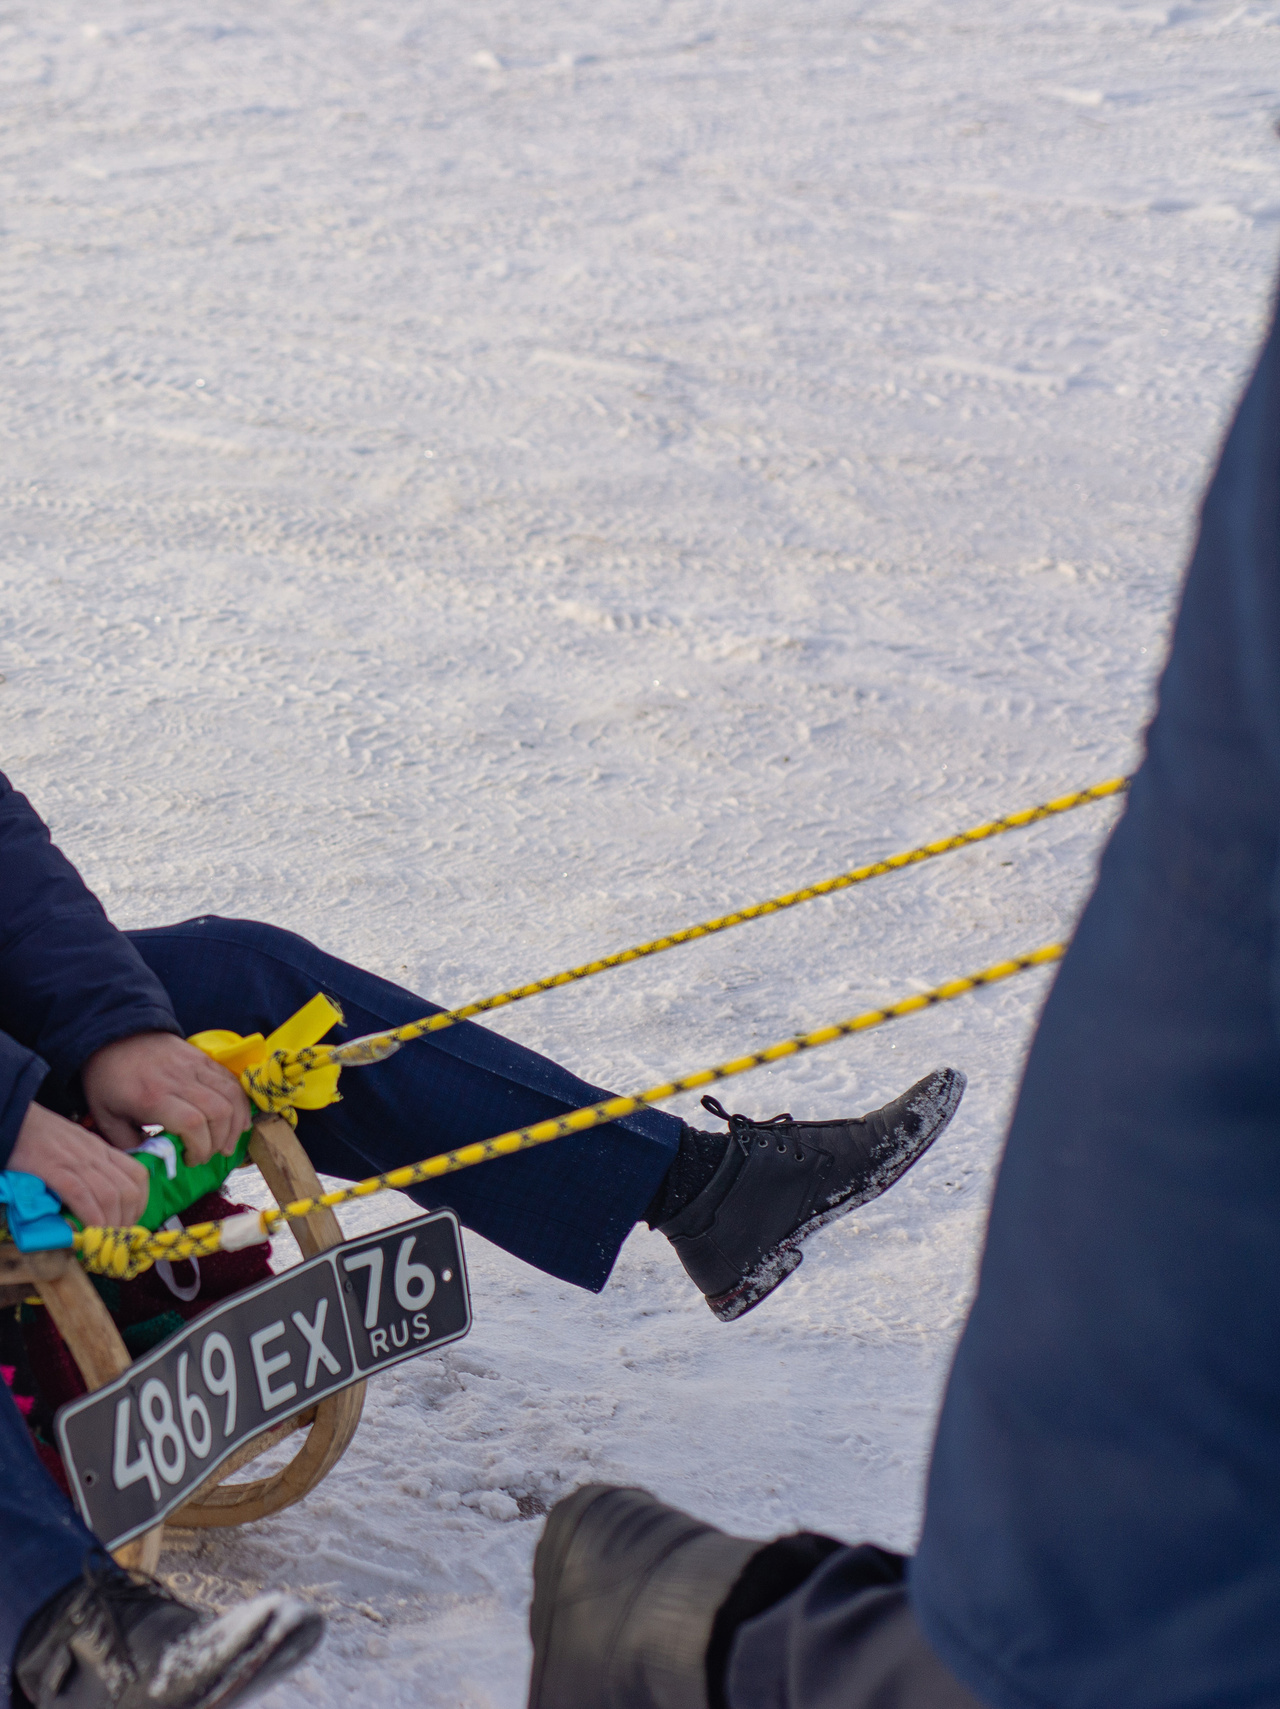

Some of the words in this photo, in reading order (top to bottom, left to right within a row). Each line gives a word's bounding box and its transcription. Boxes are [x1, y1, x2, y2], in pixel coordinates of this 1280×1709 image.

[343, 1235, 436, 1329] 76
[369, 1312, 431, 1358] RUS
[112, 1331, 238, 1501] 4869
[249, 1298, 342, 1412] EX
